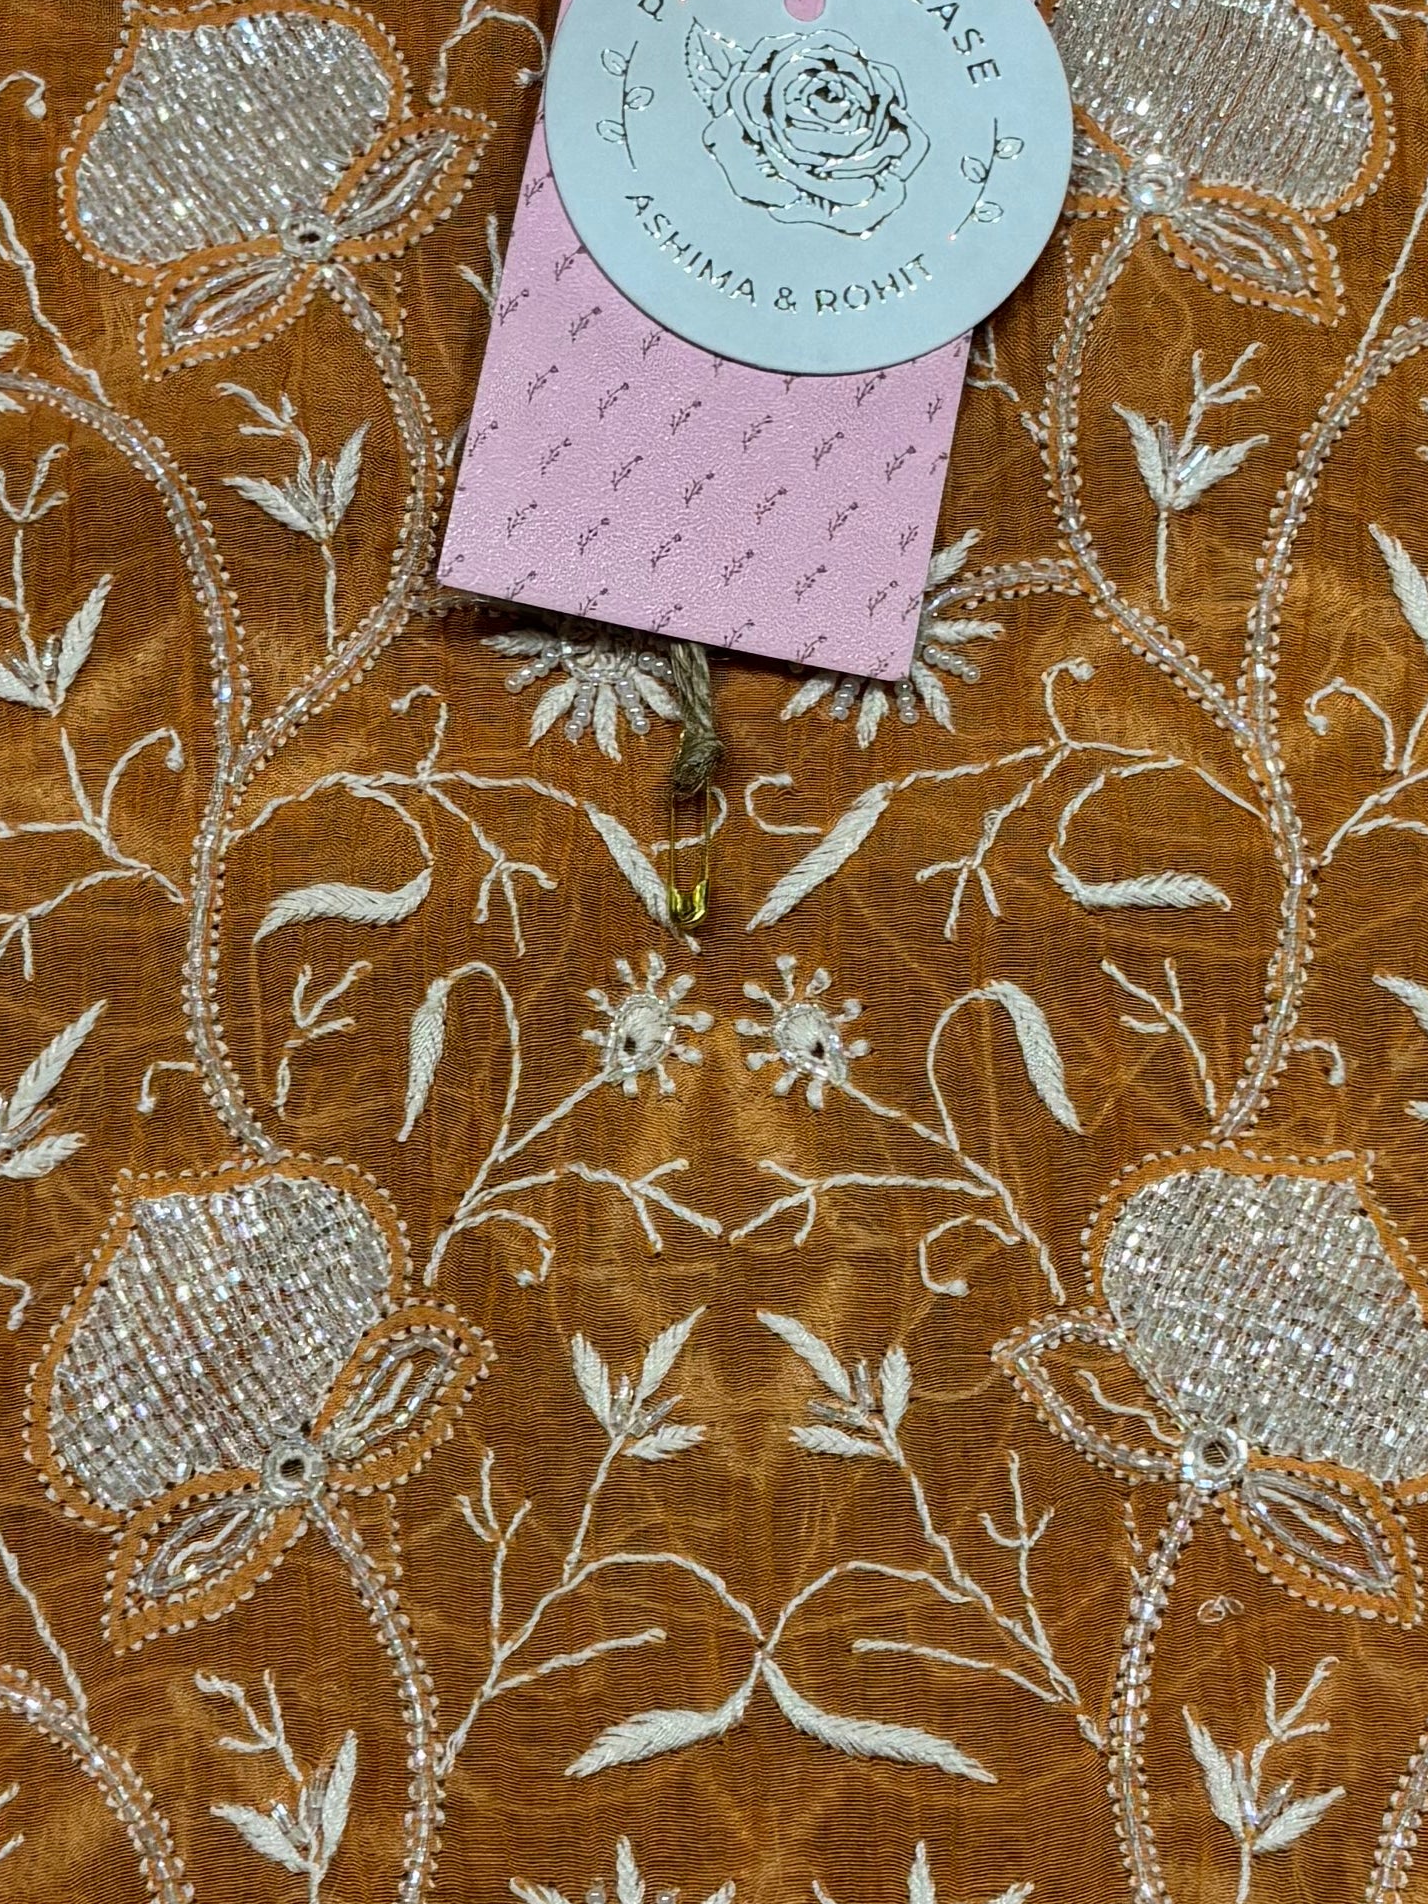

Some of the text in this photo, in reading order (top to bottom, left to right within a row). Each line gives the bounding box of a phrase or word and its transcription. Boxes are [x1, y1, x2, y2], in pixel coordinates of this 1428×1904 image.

[624, 194, 933, 315] ASHIMA & ROHIT
